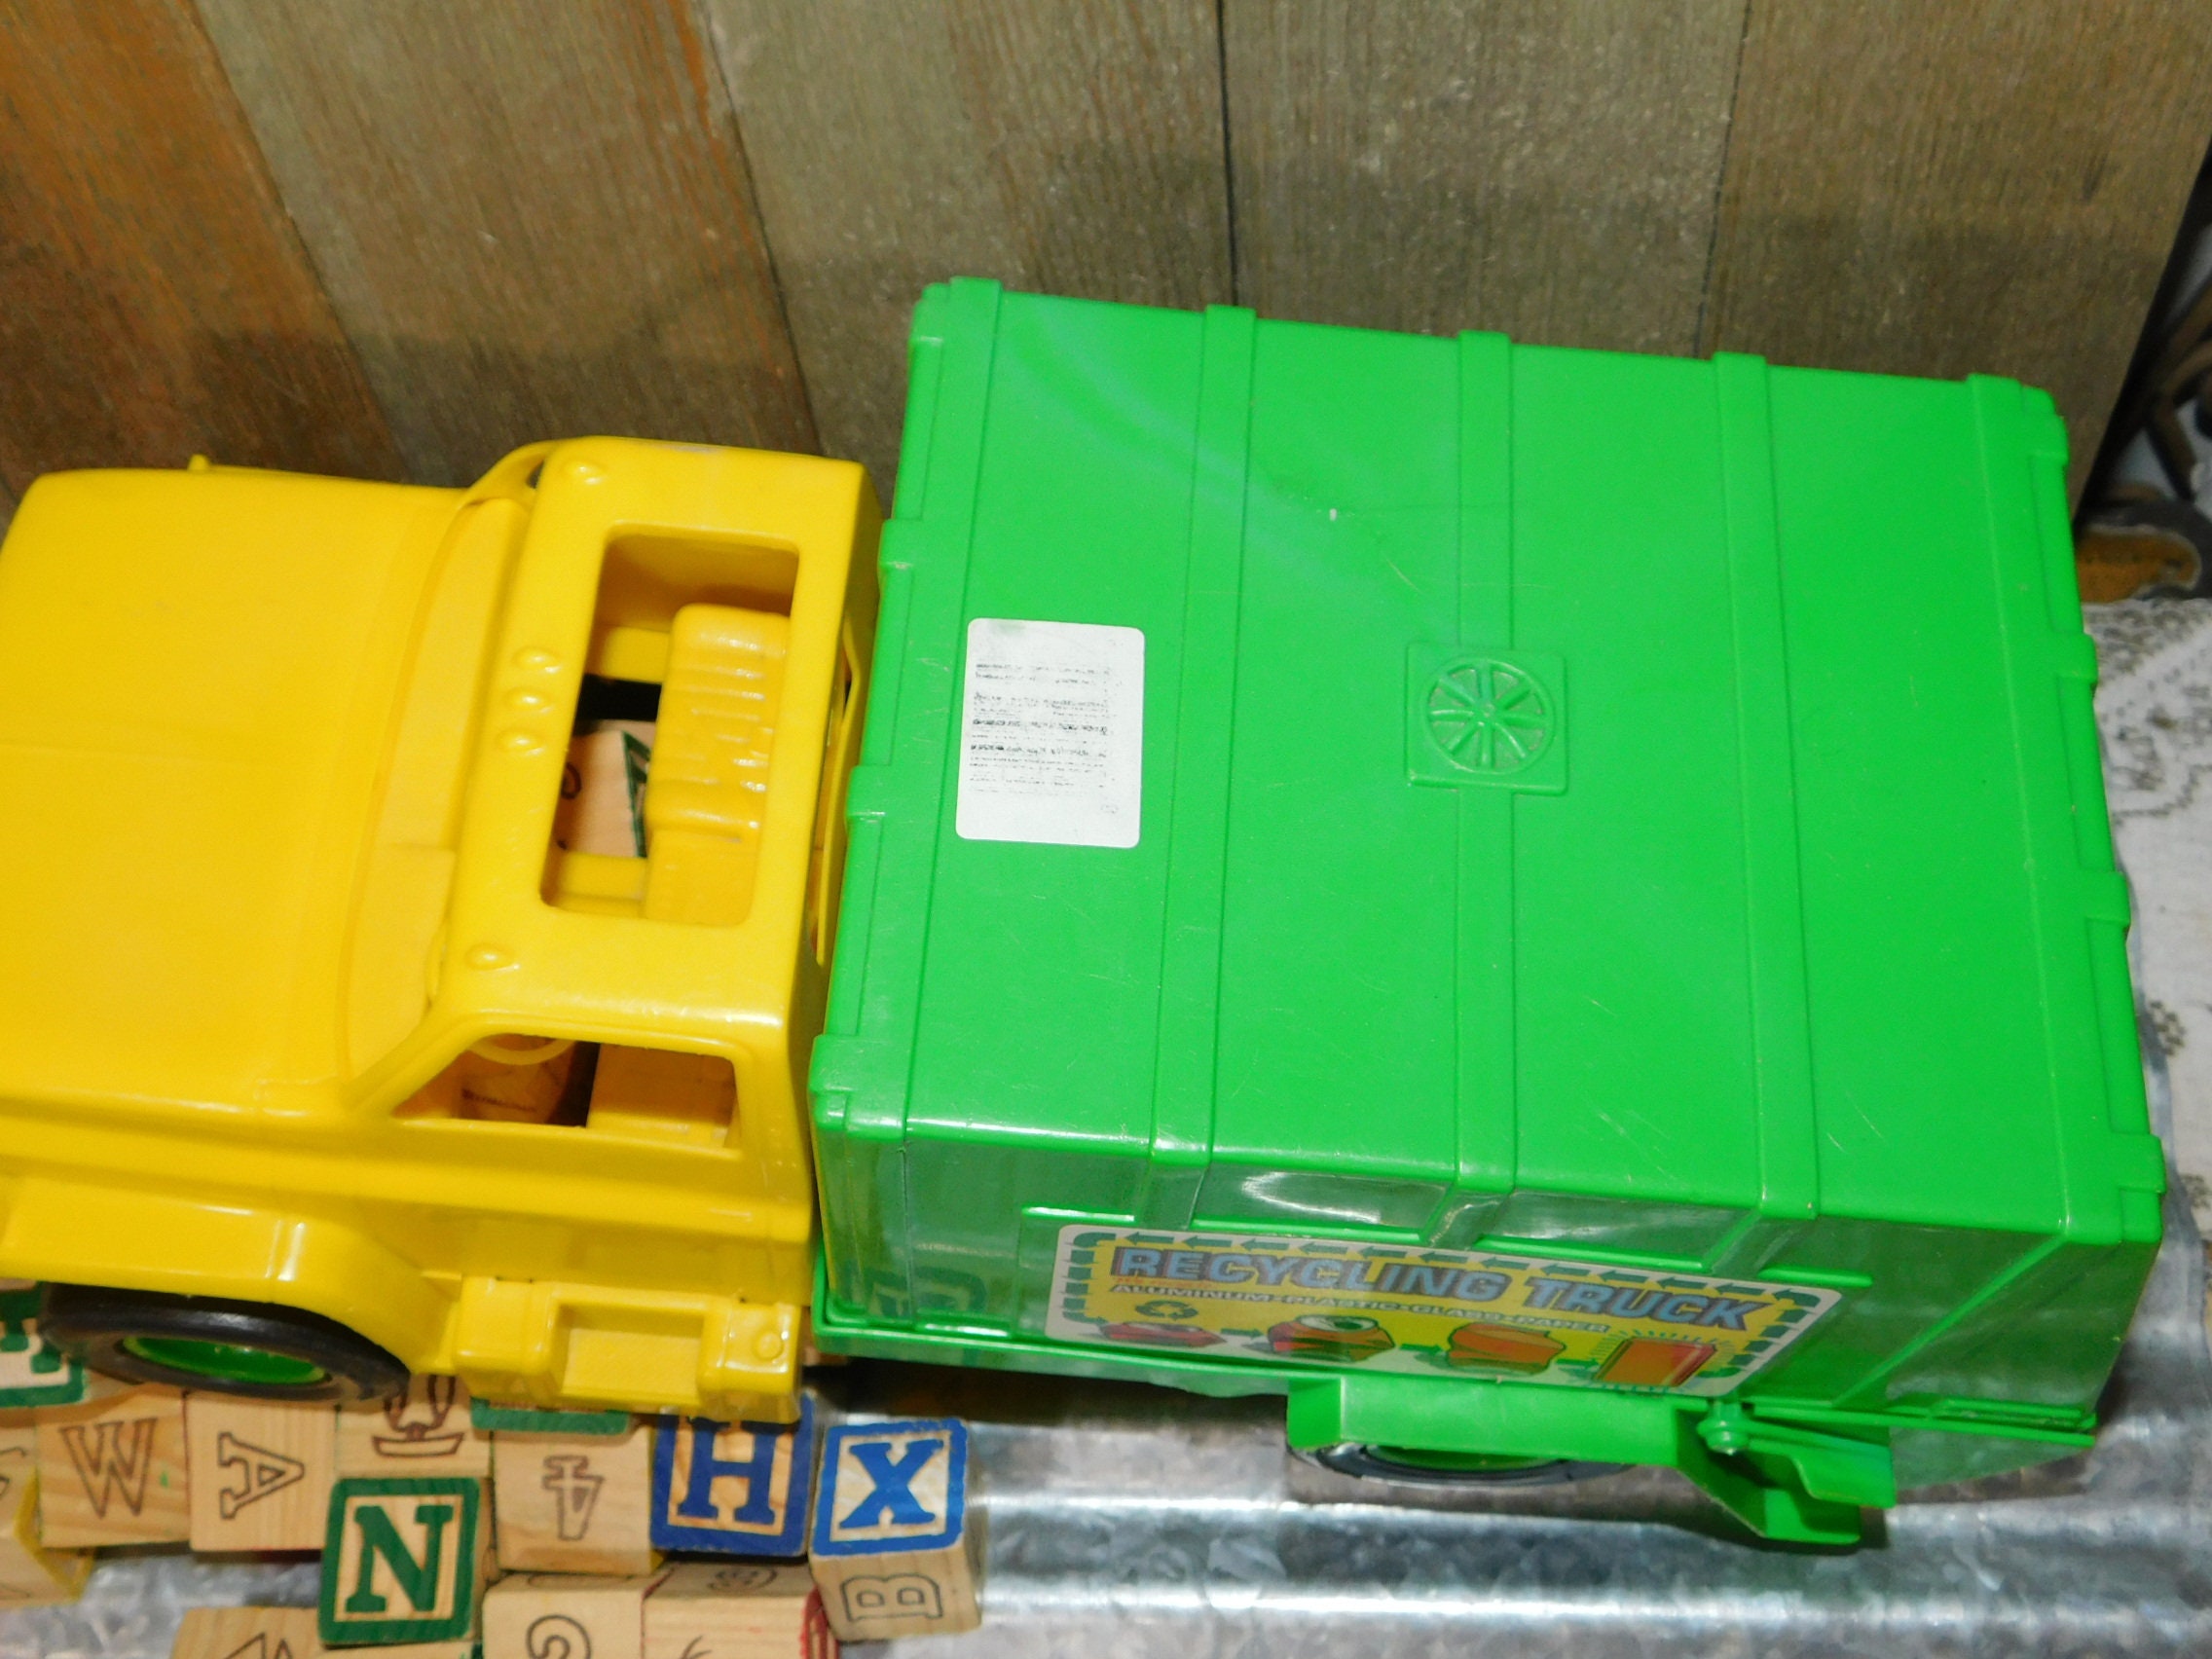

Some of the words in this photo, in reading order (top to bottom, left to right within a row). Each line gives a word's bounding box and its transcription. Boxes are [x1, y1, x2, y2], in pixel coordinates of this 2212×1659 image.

[1110, 1246, 1514, 1300] RECYCLING
[1521, 1276, 1773, 1330] TRUCK
[59, 1418, 158, 1518] W
[218, 1431, 306, 1520] A
[676, 1417, 782, 1525] H
[839, 1438, 944, 1530] X
[345, 1504, 455, 1612] N
[840, 1573, 942, 1623] B
